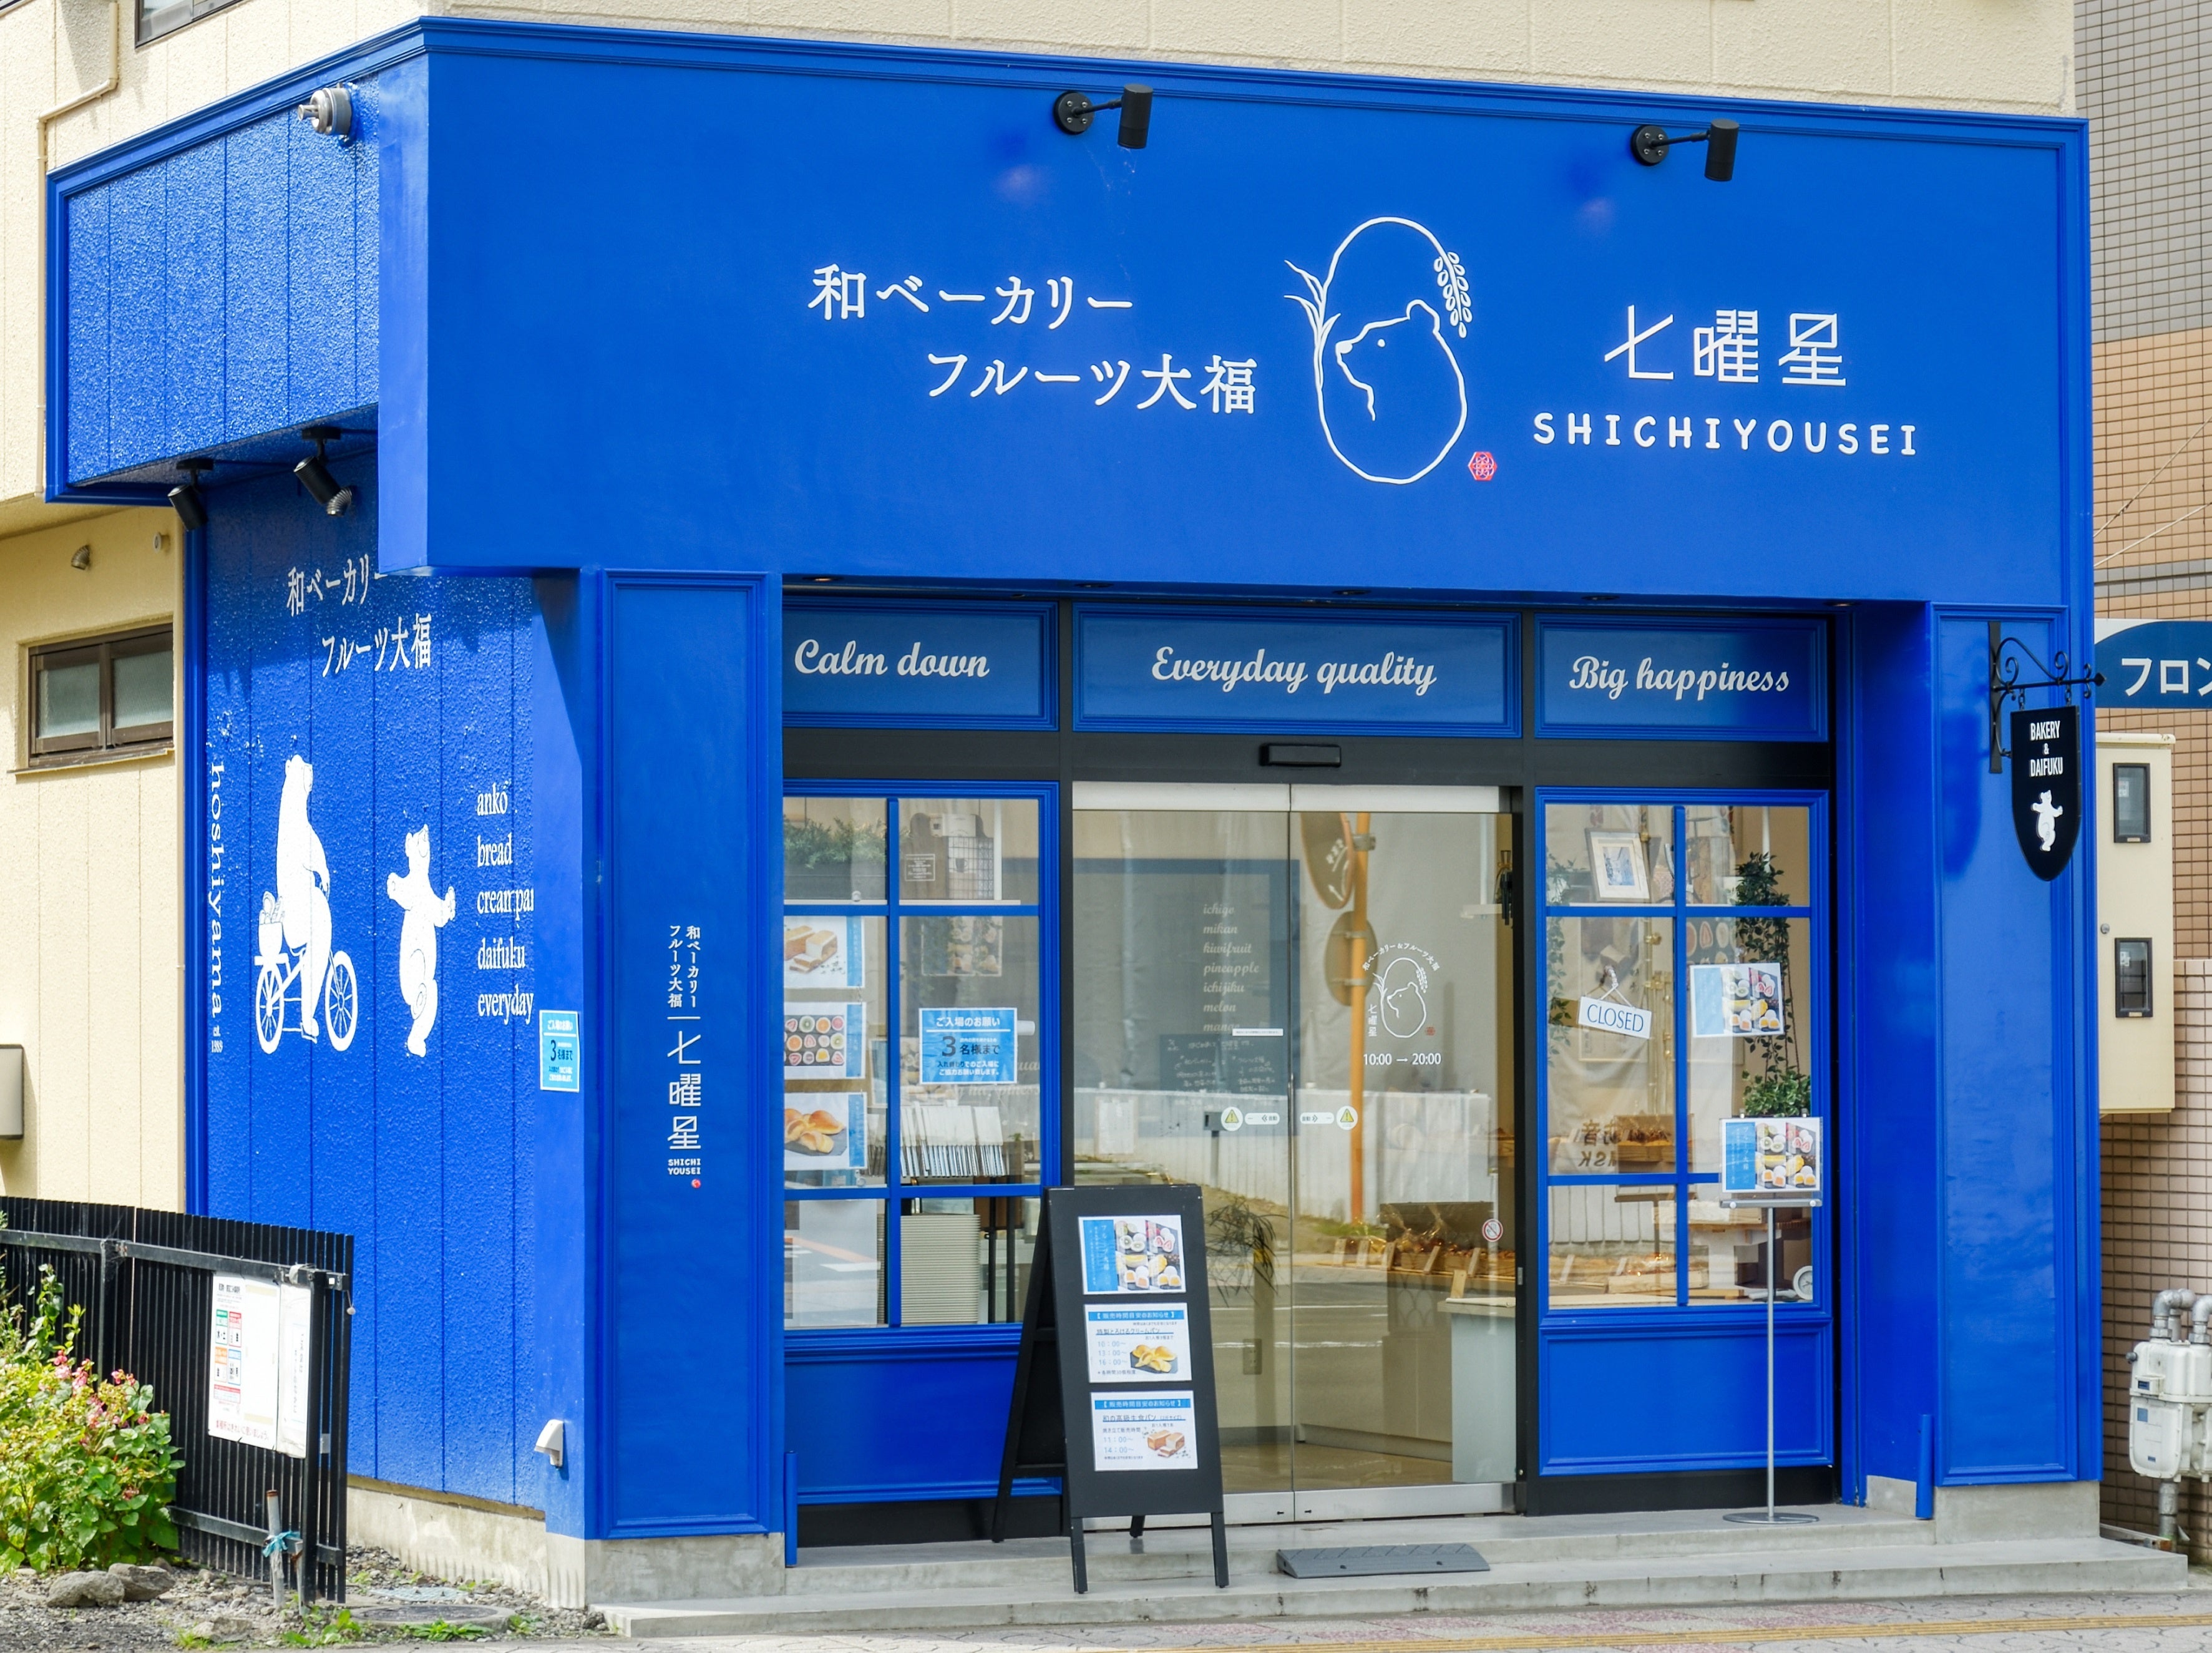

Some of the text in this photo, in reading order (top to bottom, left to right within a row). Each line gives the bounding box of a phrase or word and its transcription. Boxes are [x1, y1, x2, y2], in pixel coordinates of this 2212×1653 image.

[807, 263, 1133, 329] 和ベーカリー
[1604, 305, 1846, 386] 七曜星
[928, 353, 1257, 414] フルーツ大福
[1533, 412, 1916, 456] SHICHIYOUSEI
[322, 613, 432, 678] フルーツ大福
[794, 639, 990, 678] Calm down
[1152, 646, 1437, 696] Everyday quality
[1569, 656, 1790, 701] Big happiness
[2030, 720, 2060, 741] BAKERY
[2043, 743, 2050, 755] &
[2029, 756, 2063, 777] DAIFUKU
[477, 832, 514, 868] bread
[208, 762, 225, 1018] hoshiyama
[1203, 903, 1234, 917] ichigo
[1203, 922, 1238, 934] mikan
[477, 936, 526, 970] daifuku
[1203, 941, 1252, 957] kiwifruit
[668, 925, 683, 1008] フルーツ大福
[686, 925, 701, 1008] 和ベーカリー
[1203, 961, 1259, 977] pineapple
[1203, 981, 1245, 997] ichijiku
[477, 983, 534, 1025] everyday
[1203, 1000, 1236, 1012] melon
[1587, 1004, 1644, 1032] CLOSED
[936, 1017, 1000, 1027] ご入場のお願い
[550, 1040, 557, 1061] 3
[942, 1035, 1000, 1056] 3 名様まで
[1363, 1053, 1441, 1066] 10:00 20:00
[667, 1030, 701, 1149] 七曜星
[668, 1158, 701, 1166] SHICHI
[668, 1167, 701, 1175] YOUSEI
